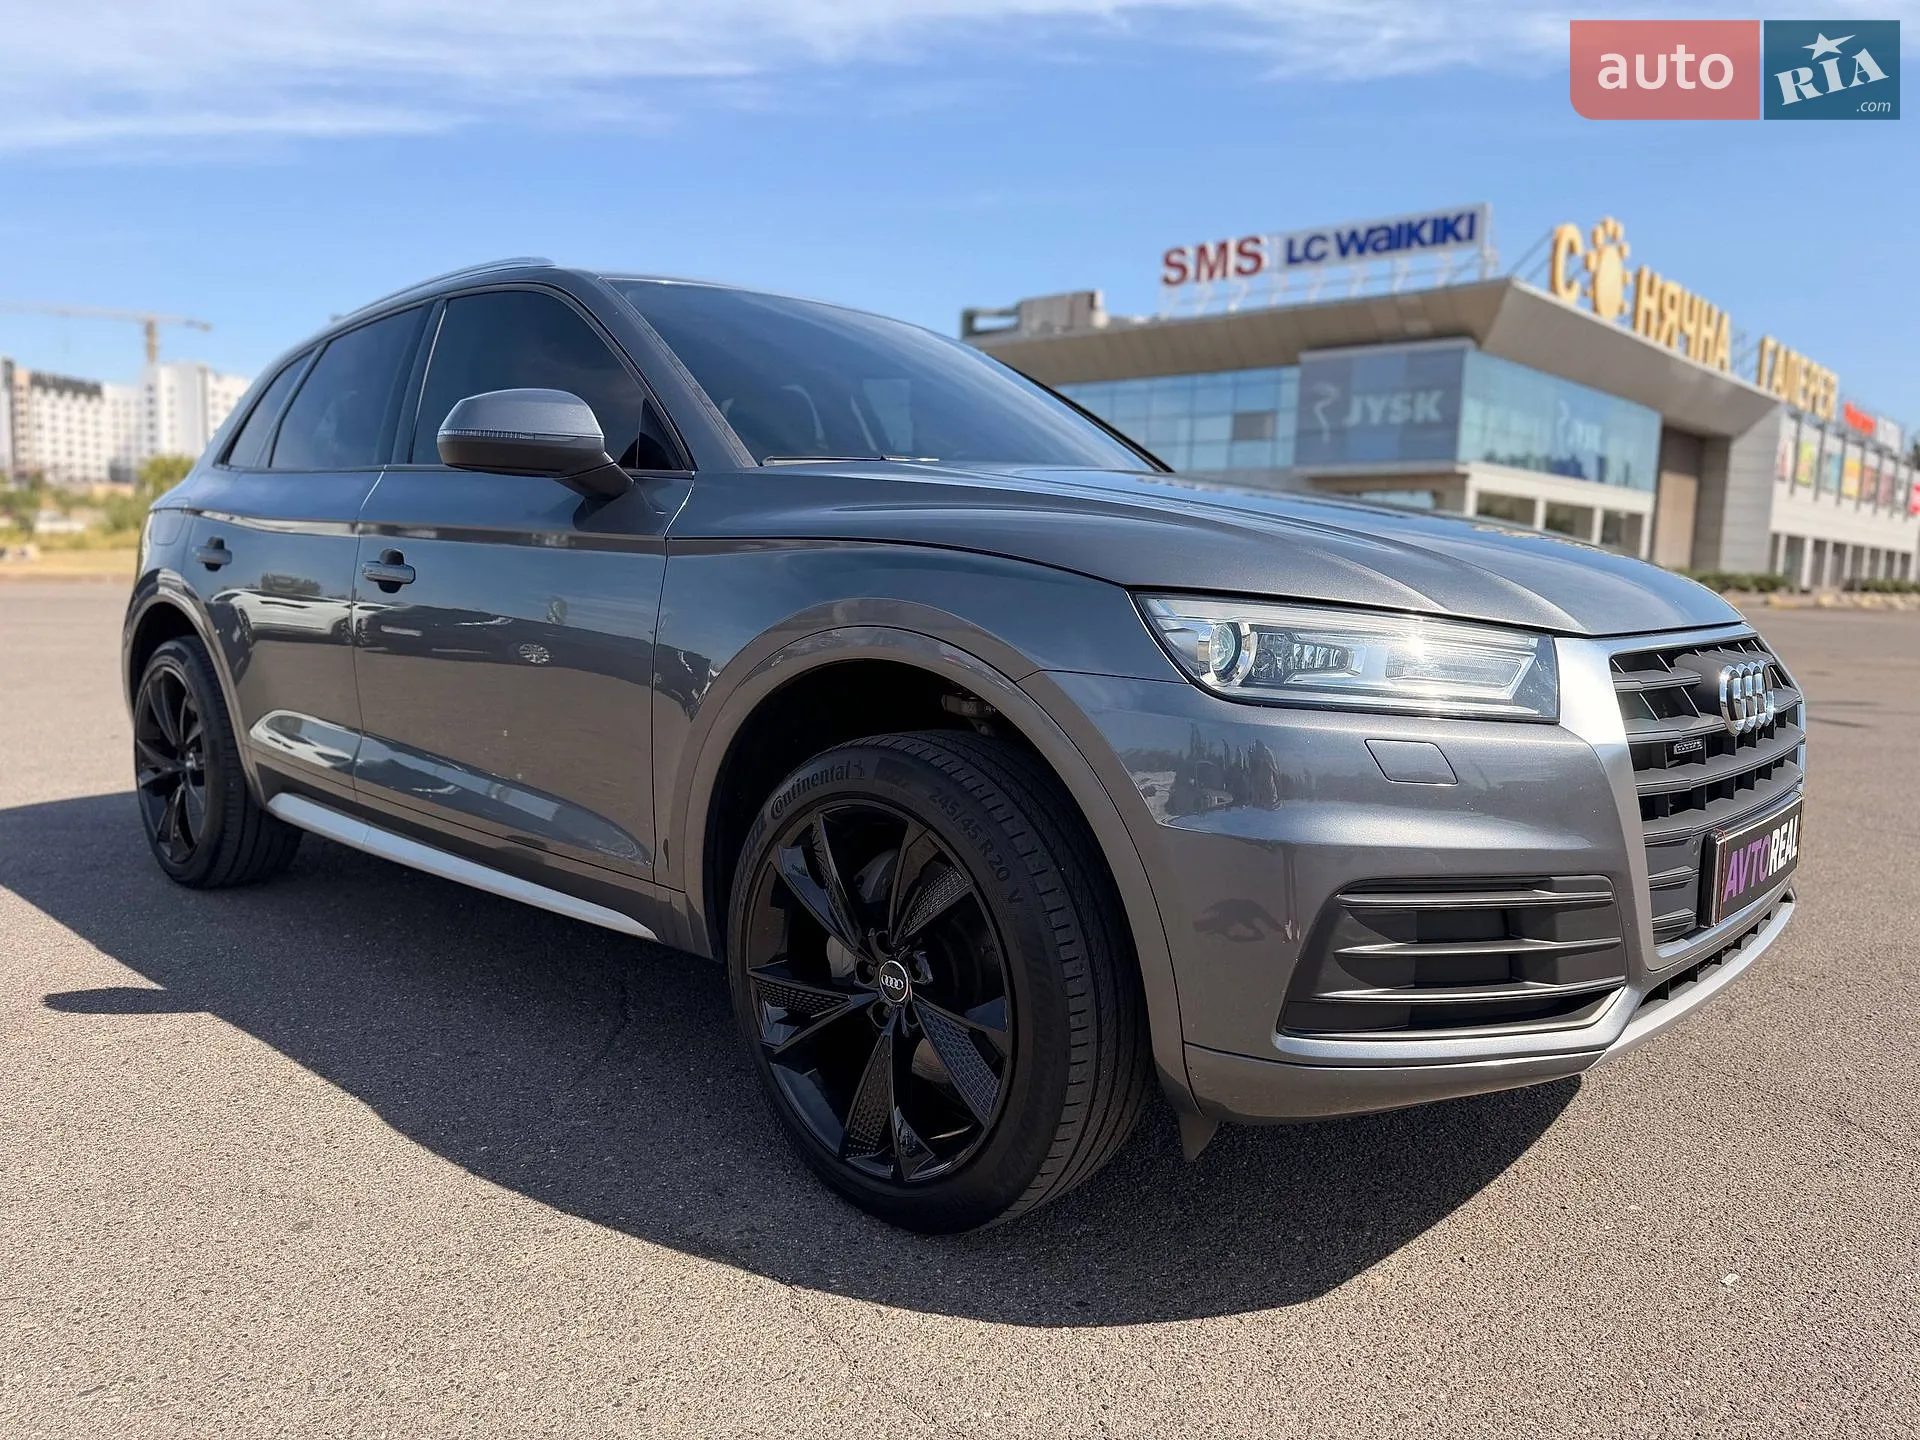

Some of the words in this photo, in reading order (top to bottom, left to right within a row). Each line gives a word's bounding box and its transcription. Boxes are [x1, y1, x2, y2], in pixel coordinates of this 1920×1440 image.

[1162, 235, 1264, 287] SMS
[1286, 233, 1329, 265] LC
[1345, 389, 1446, 428] JYSK
[770, 759, 850, 820] Continental
